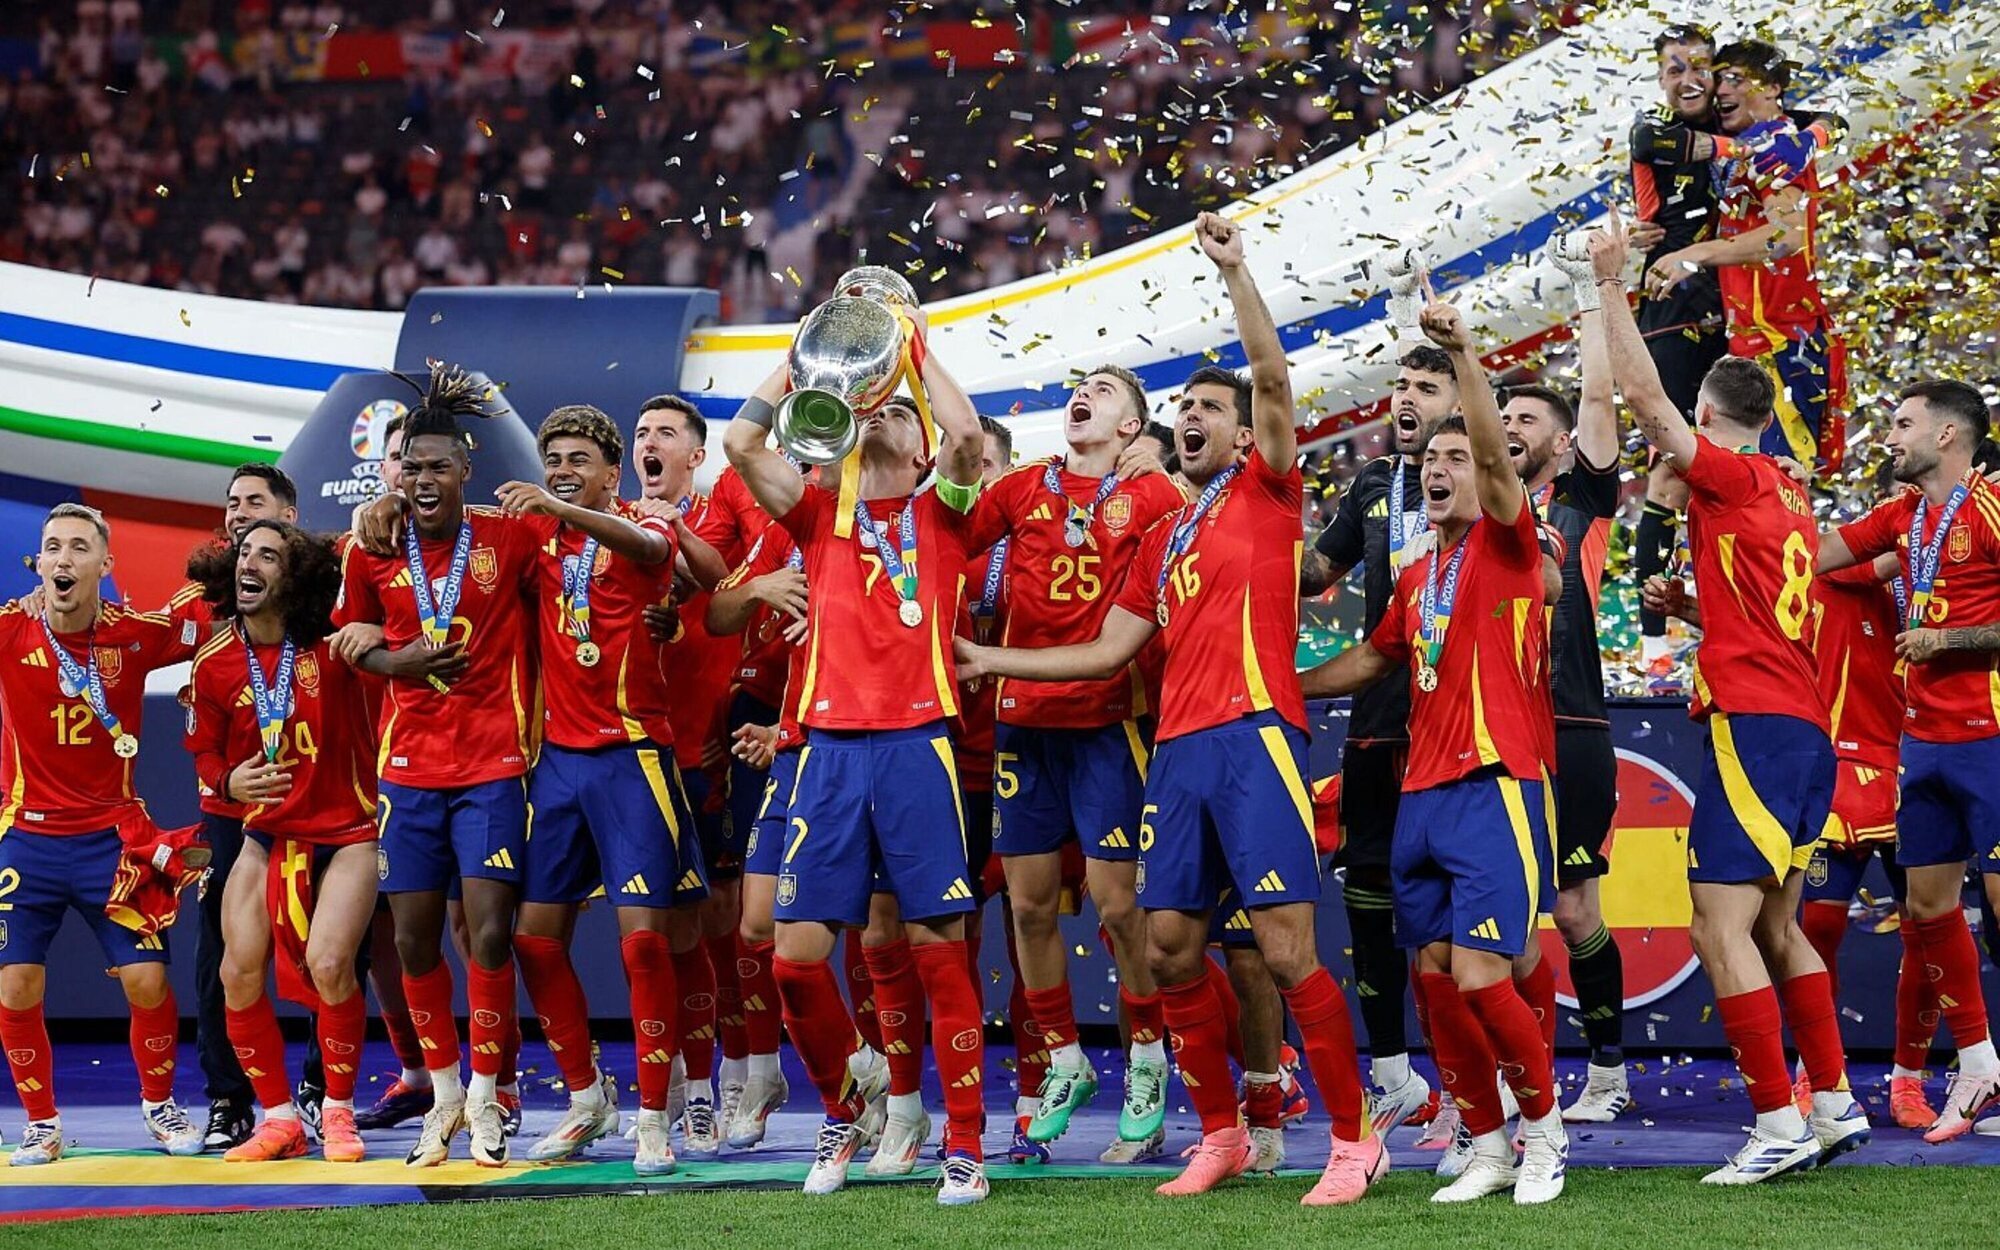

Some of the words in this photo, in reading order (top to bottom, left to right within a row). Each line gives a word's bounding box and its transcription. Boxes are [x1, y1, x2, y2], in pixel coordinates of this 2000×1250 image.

[860, 553, 883, 597] 7
[1050, 554, 1101, 601] 25
[1169, 551, 1202, 607] 16
[1775, 531, 1813, 640] 8
[1922, 579, 1950, 623] 5
[50, 703, 94, 745] 12
[275, 720, 319, 767] 24
[783, 816, 809, 864] 7
